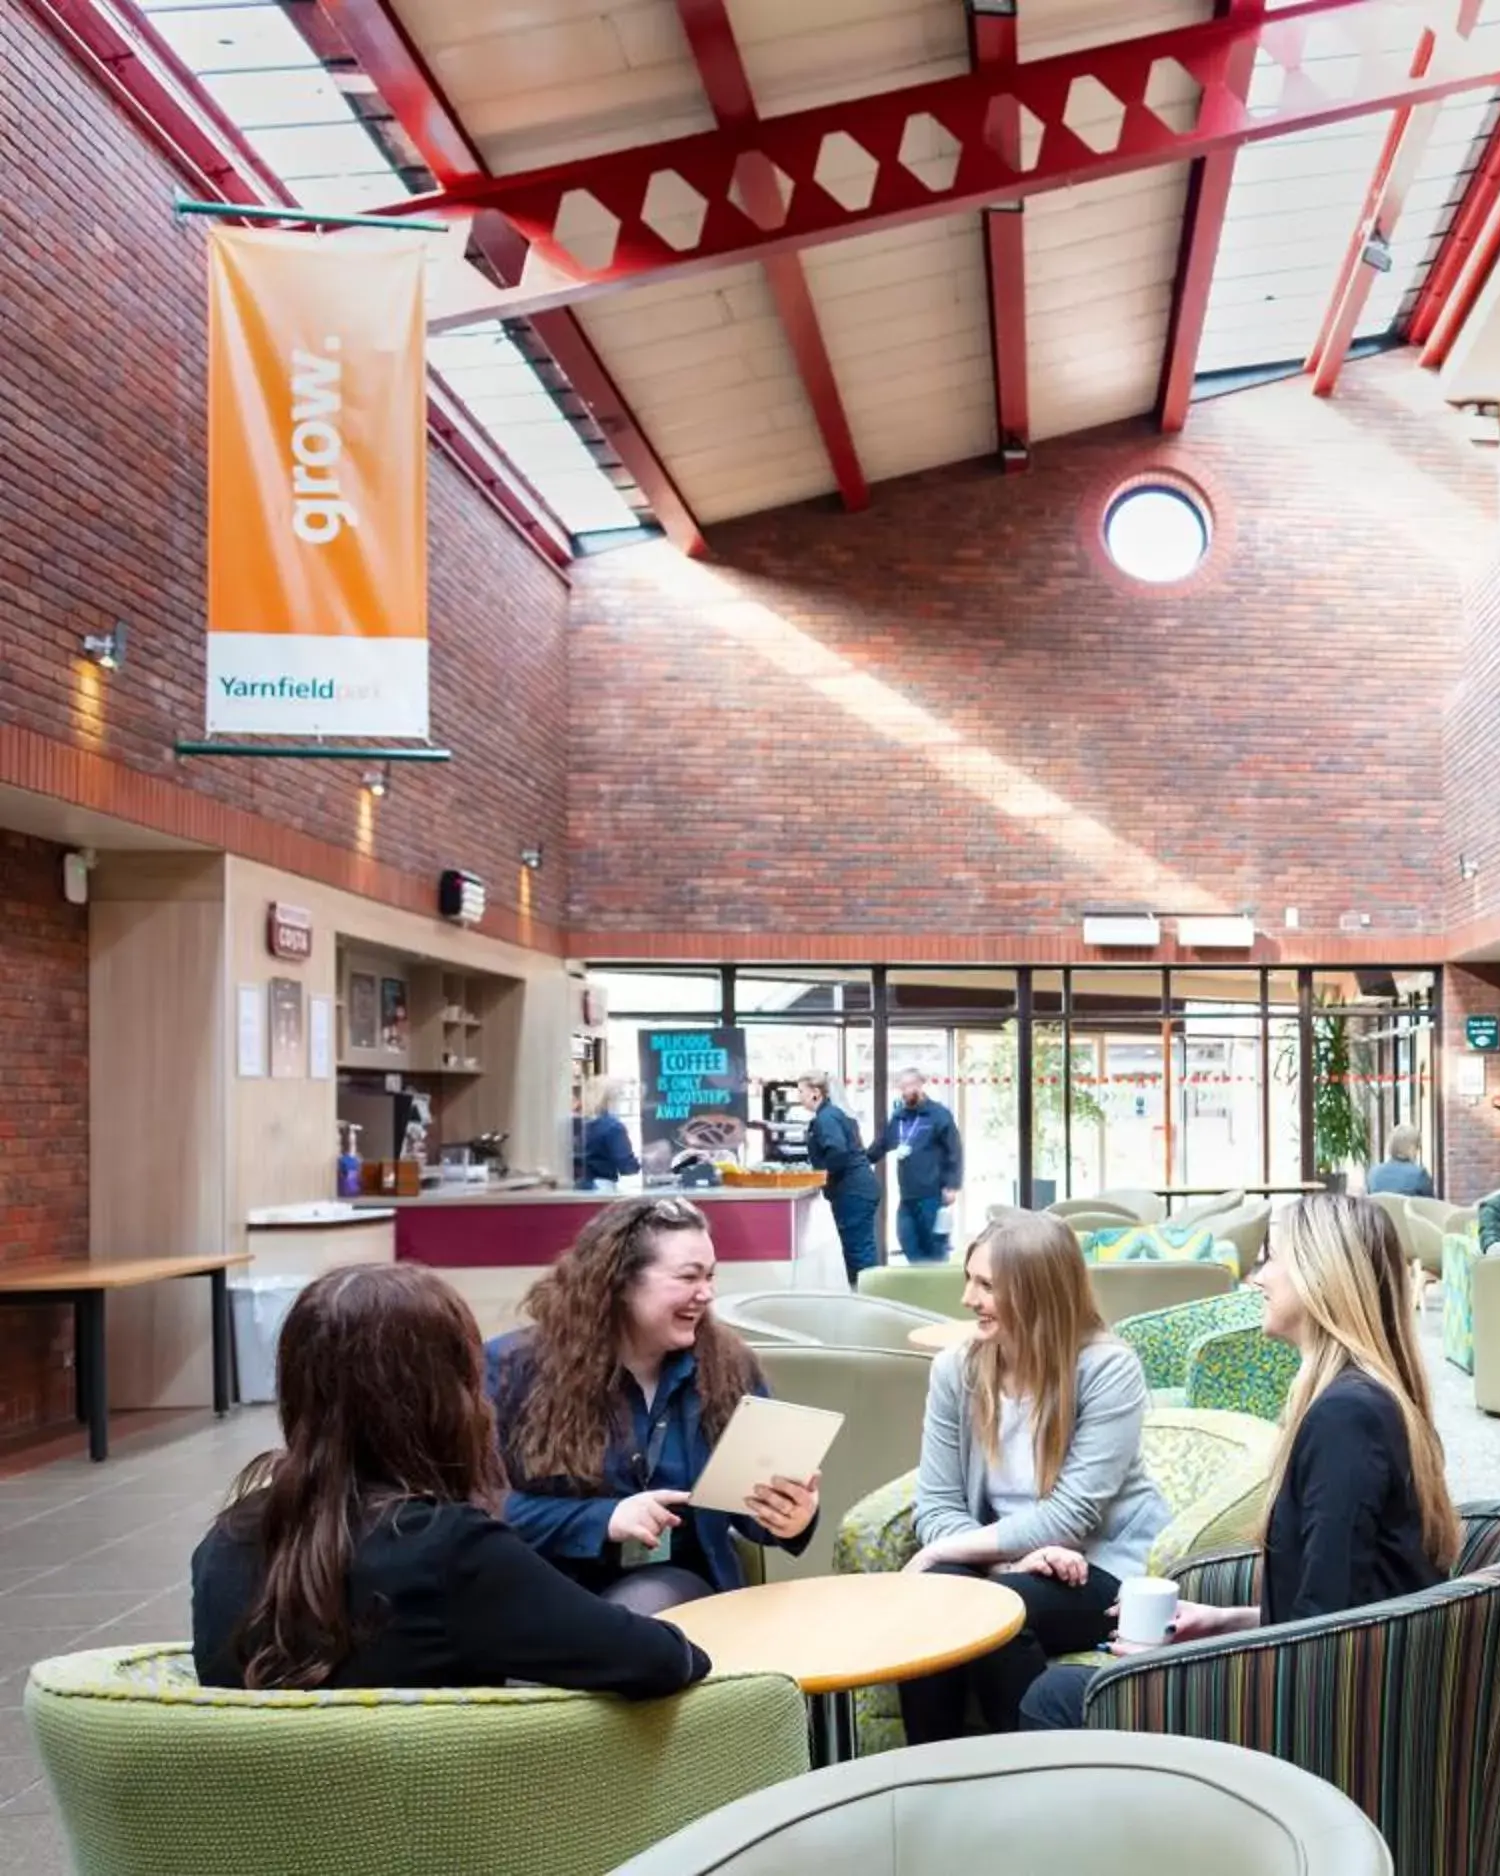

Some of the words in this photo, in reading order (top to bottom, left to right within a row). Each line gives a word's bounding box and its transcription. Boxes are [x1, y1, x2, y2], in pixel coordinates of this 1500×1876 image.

[291, 334, 358, 545] grow.
[279, 925, 308, 952] COSTA
[650, 1034, 713, 1051] DELICIOUS
[666, 1052, 721, 1072] COFFEE
[657, 1076, 668, 1091] IS
[671, 1076, 702, 1091] ONLY
[666, 1089, 731, 1105] FOOTSTEPS
[655, 1104, 690, 1120] AWAY
